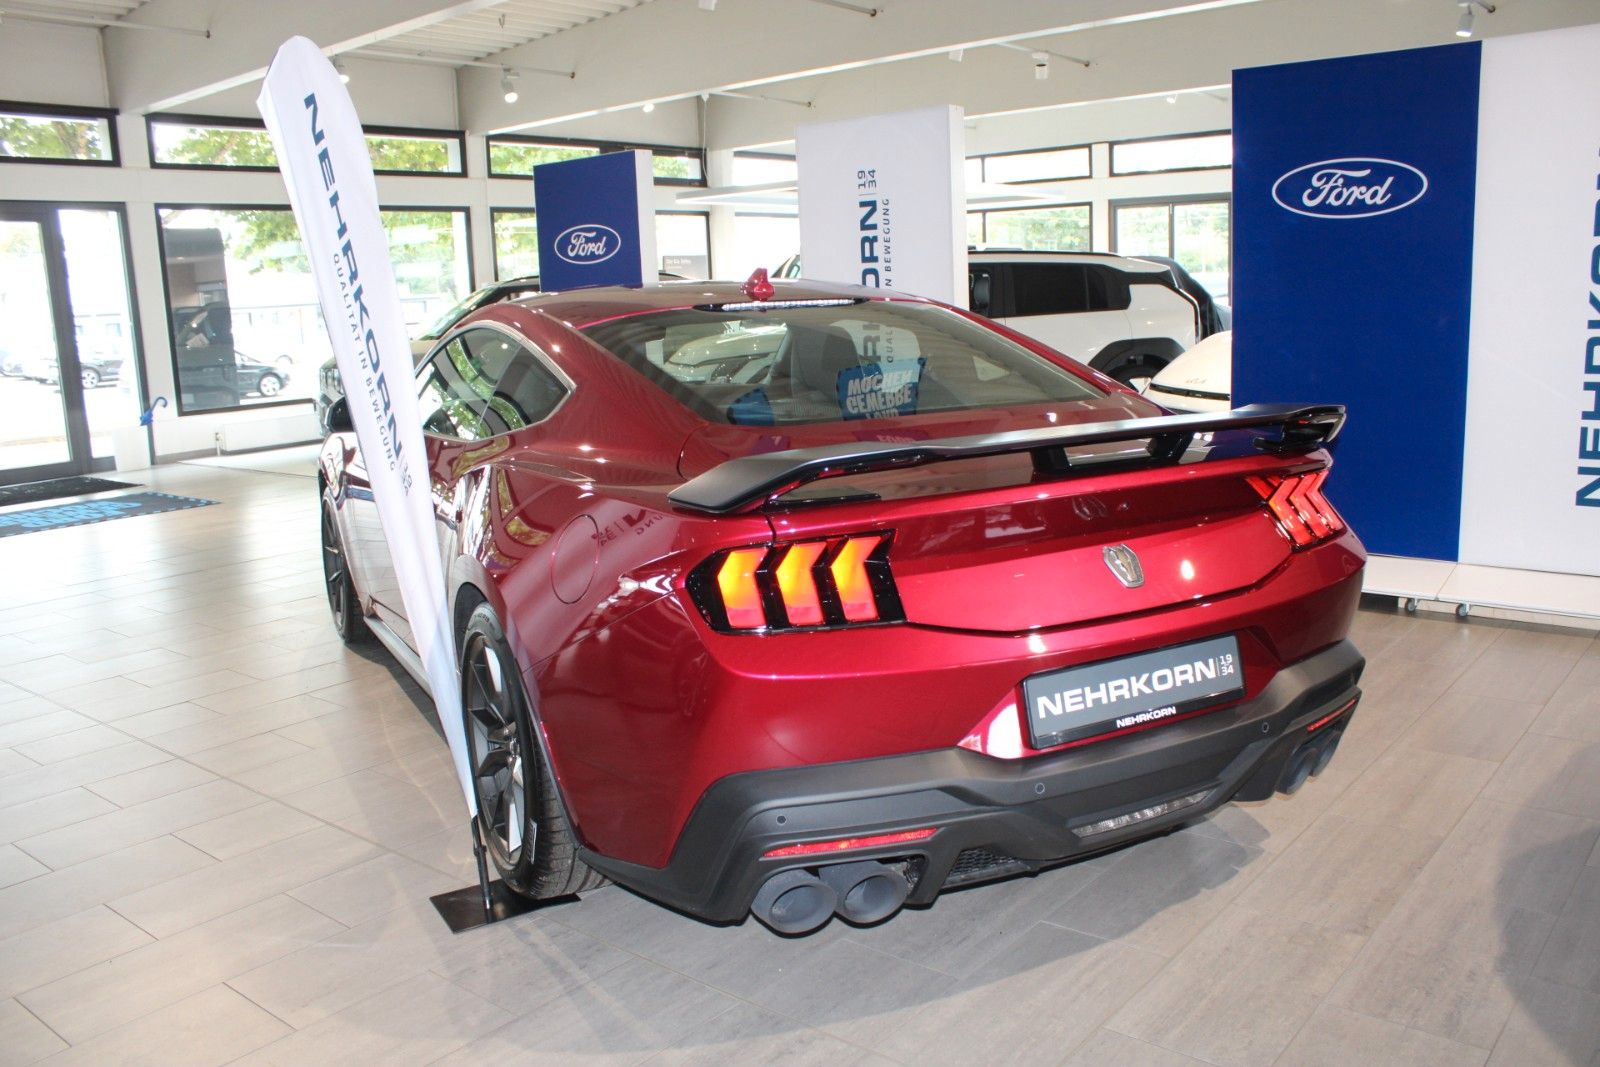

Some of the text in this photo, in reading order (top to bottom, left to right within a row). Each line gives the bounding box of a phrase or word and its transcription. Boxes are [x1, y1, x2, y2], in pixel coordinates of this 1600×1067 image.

[857, 170, 867, 190] 19
[867, 168, 877, 189] 34
[1302, 168, 1395, 207] Ford
[567, 231, 606, 257] Ford
[882, 198, 892, 272] BEWEGUNG
[304, 93, 402, 461] NEHRKORN
[357, 351, 369, 370] IN
[365, 377, 396, 472] BEWEGUNG
[1219, 654, 1233, 665] 19
[1221, 665, 1234, 676] 34
[1037, 658, 1216, 719] NEHRKORN
[1116, 706, 1176, 728] NEHRKORN
